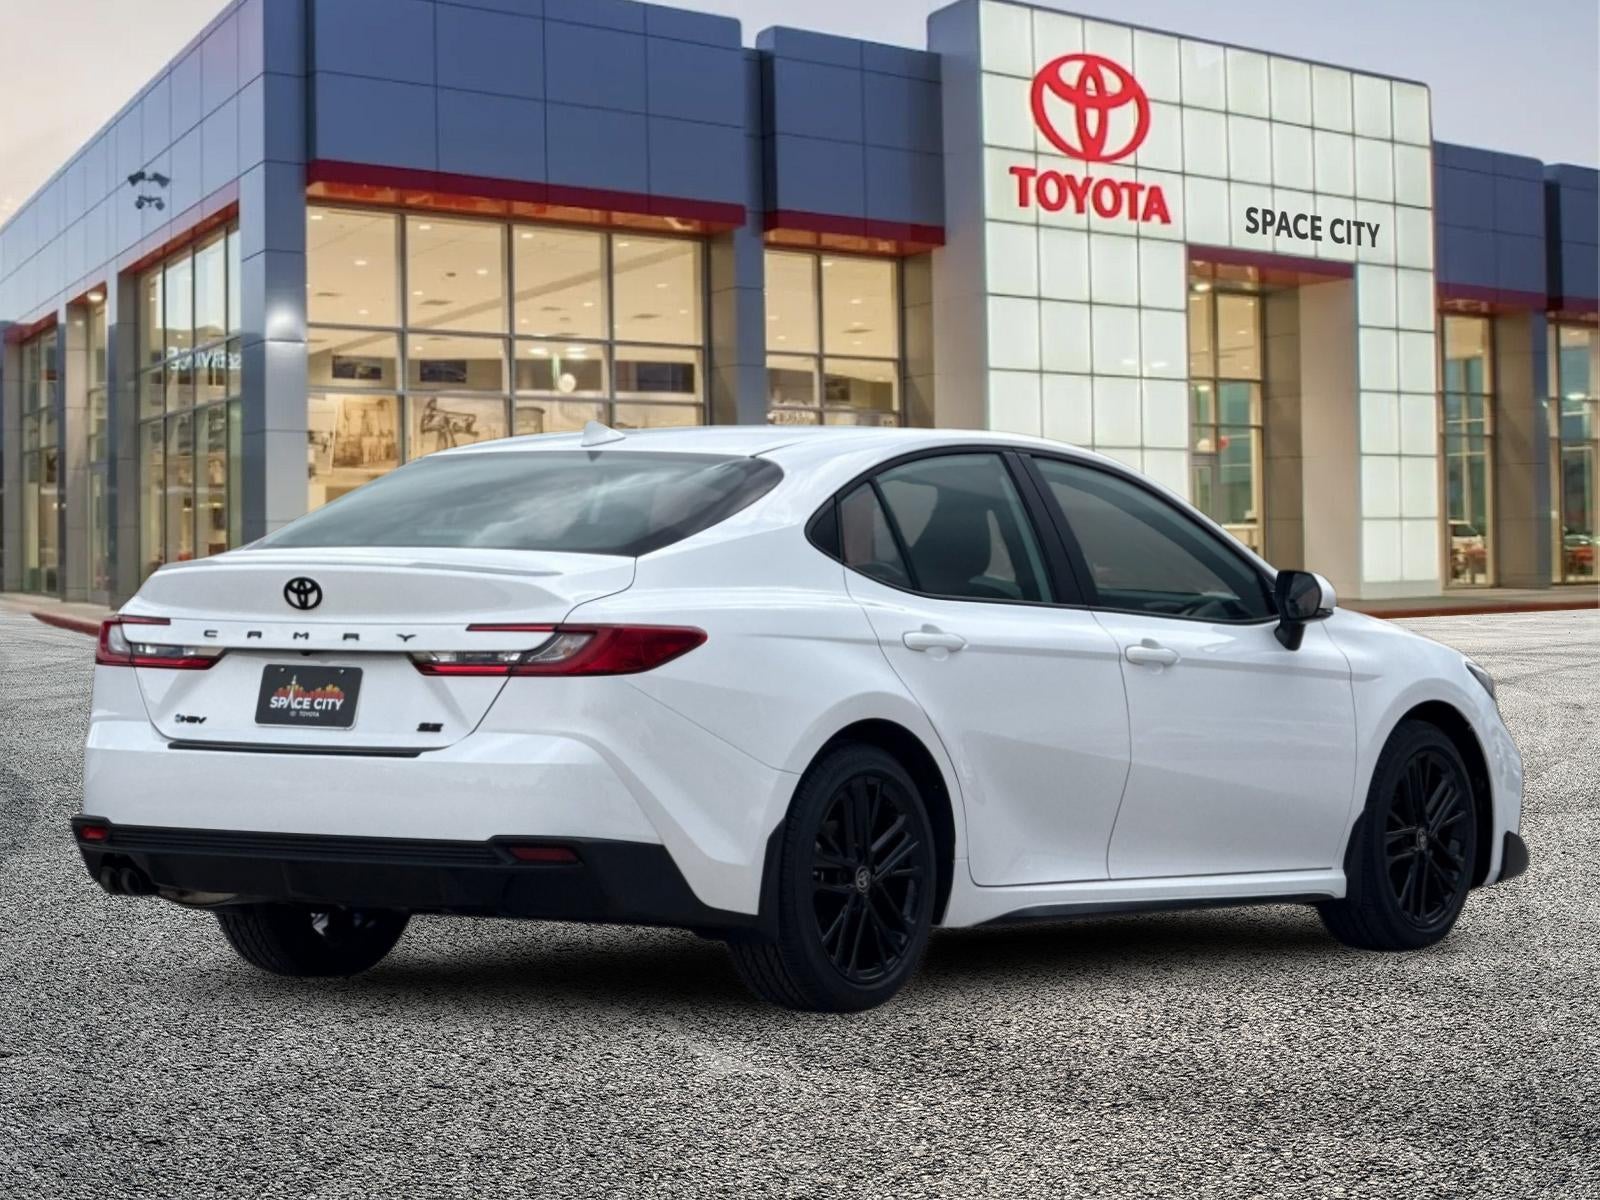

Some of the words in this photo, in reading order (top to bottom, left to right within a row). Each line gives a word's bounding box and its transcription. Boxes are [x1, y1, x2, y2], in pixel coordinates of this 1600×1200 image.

[1009, 166, 1171, 225] TOYOTA
[1245, 206, 1323, 242] SPACE
[1329, 217, 1381, 248] CITY
[203, 629, 416, 642] CAMRY
[269, 695, 312, 710] SPACE
[313, 697, 345, 711] CITY
[298, 710, 321, 718] TOYOTA
